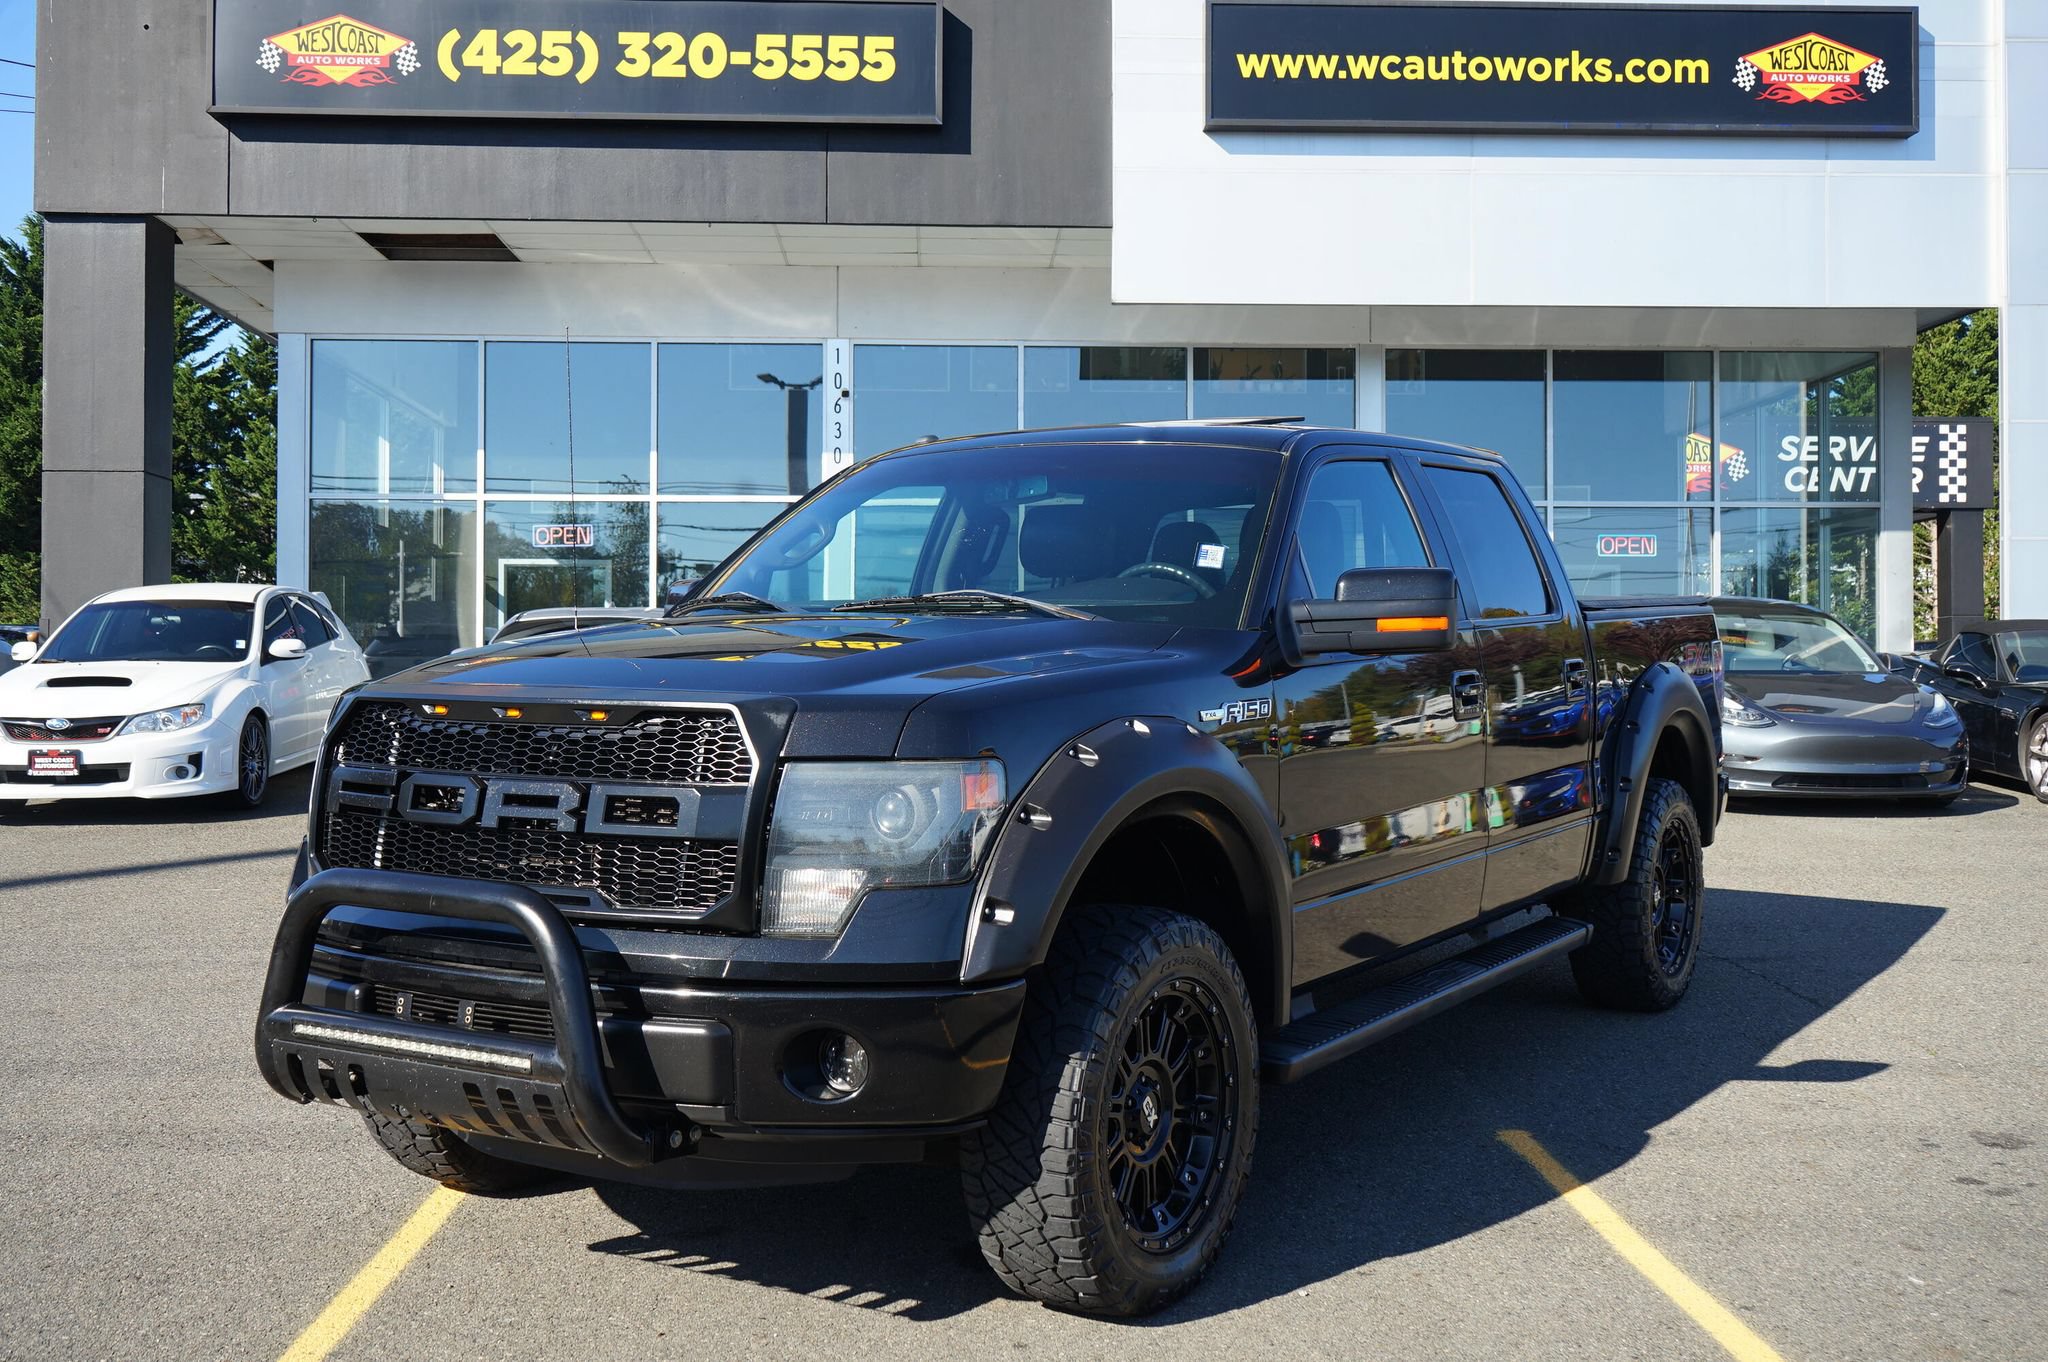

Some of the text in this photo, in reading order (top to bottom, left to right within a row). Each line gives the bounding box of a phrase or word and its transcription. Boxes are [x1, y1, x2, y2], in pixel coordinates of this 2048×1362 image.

[296, 56, 381, 65] AUTO WORKS
[437, 27, 896, 85] (425) 320-5555
[1236, 48, 1710, 84] www.wcautoworks.com
[1770, 73, 1851, 83] AUTO WORKS
[833, 347, 843, 464] 10630
[535, 526, 590, 545] OPEN
[1601, 536, 1654, 554] OPEN
[1222, 698, 1271, 724] F-150
[329, 767, 701, 836] FORD
